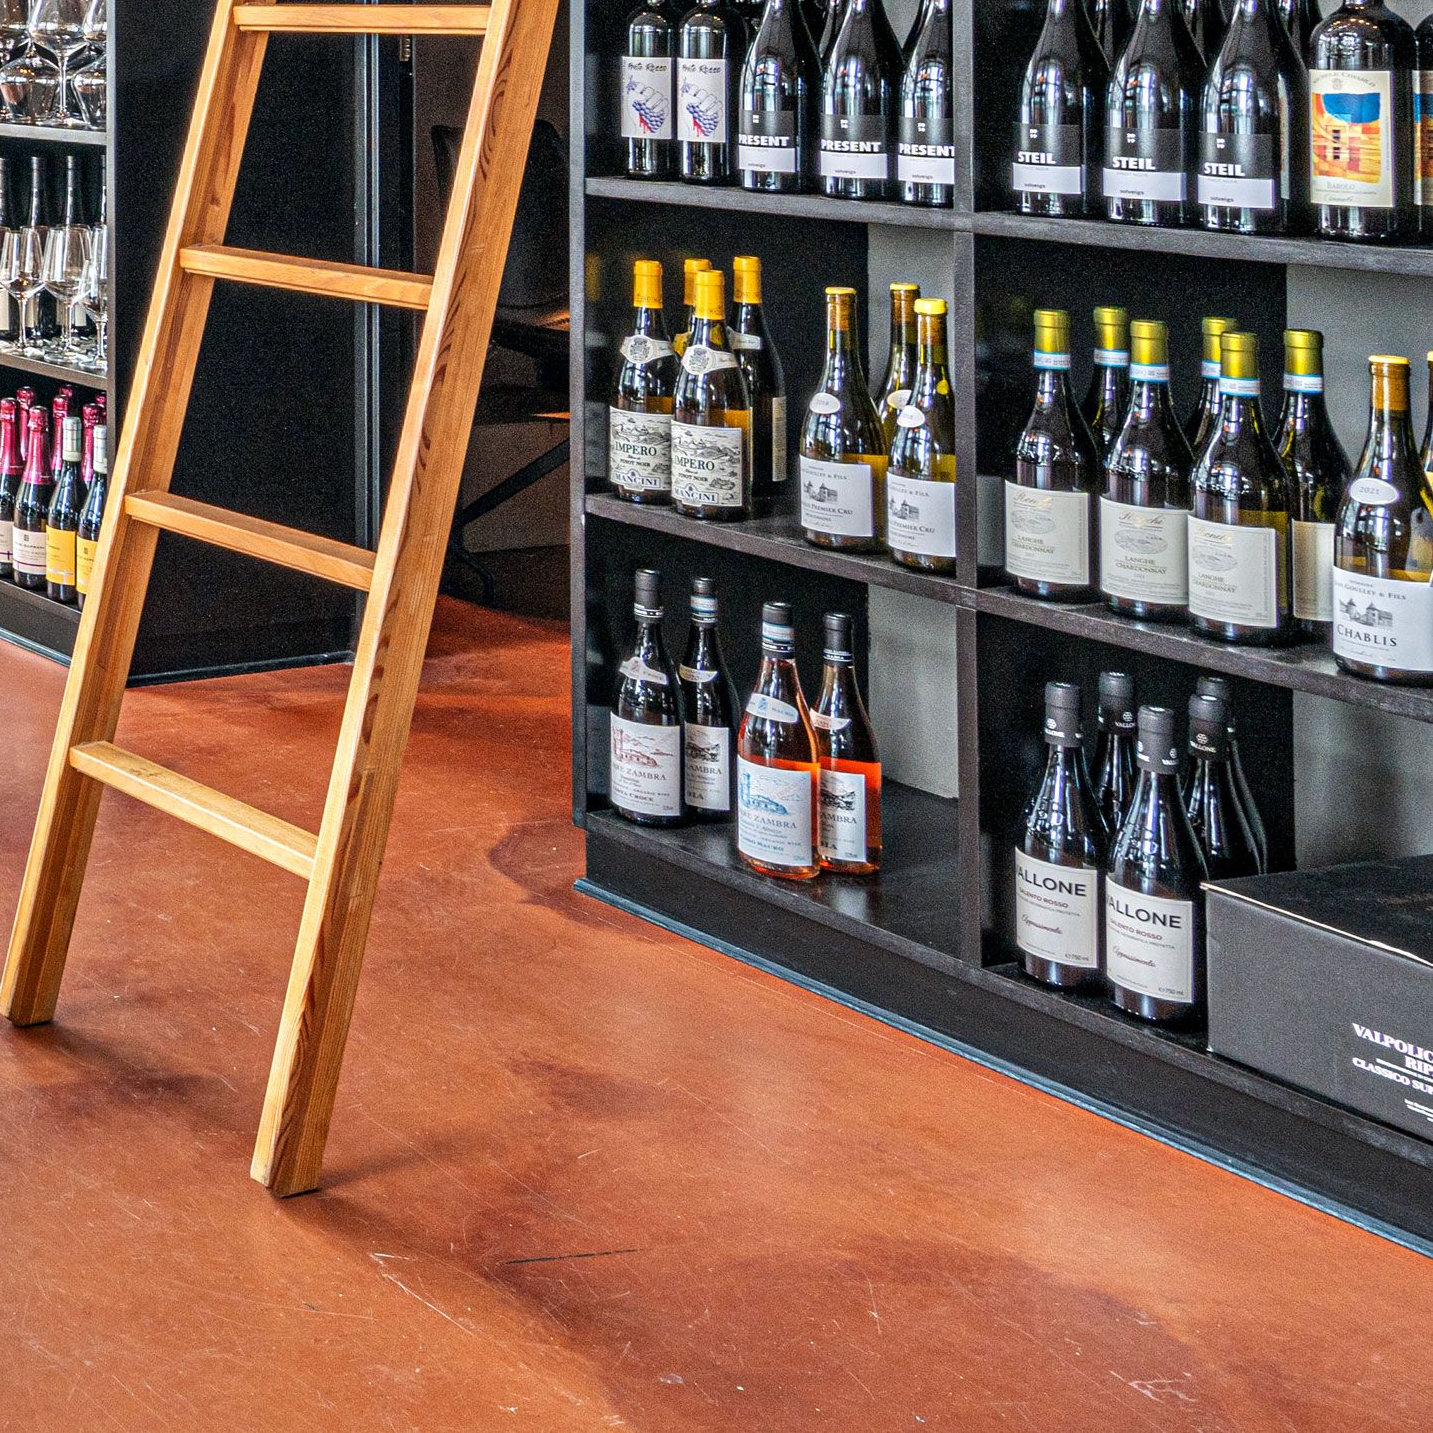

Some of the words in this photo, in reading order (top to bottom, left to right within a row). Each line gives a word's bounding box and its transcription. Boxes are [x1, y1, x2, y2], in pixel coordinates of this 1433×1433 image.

[738, 133, 790, 147] PRESENT
[820, 138, 882, 153] PRESENT
[898, 142, 955, 157] PRESENT
[1017, 150, 1057, 165] STEIL
[1112, 156, 1157, 171] STEIL
[1203, 162, 1247, 177] STEIL
[615, 441, 658, 457] IMPERO
[673, 456, 715, 471] IMPERO
[615, 473, 658, 487] MANCINI
[1358, 486, 1381, 495] 2021
[837, 506, 854, 516] CRU
[918, 524, 936, 534] CRU
[1017, 534, 1045, 545] LANGHE
[1123, 555, 1156, 566] LANGHE
[1115, 562, 1167, 576] CHARDONNAY
[1197, 571, 1226, 584] LANGHE
[1192, 578, 1238, 594] CHARDONNAY
[1344, 584, 1377, 596] GOULLEY
[1387, 591, 1407, 601] FILS
[1336, 623, 1398, 648] CHABLIS
[625, 767, 668, 782] ZAMBRA
[686, 764, 723, 776] AMBRA
[753, 816, 798, 830] ZAMBRA
[820, 811, 858, 825] AMBRA
[1017, 869, 1088, 898] ALLONE
[1043, 897, 1069, 909] ROSSO
[1134, 929, 1163, 941] ROSSO
[1352, 1057, 1411, 1086] CLASSICO
